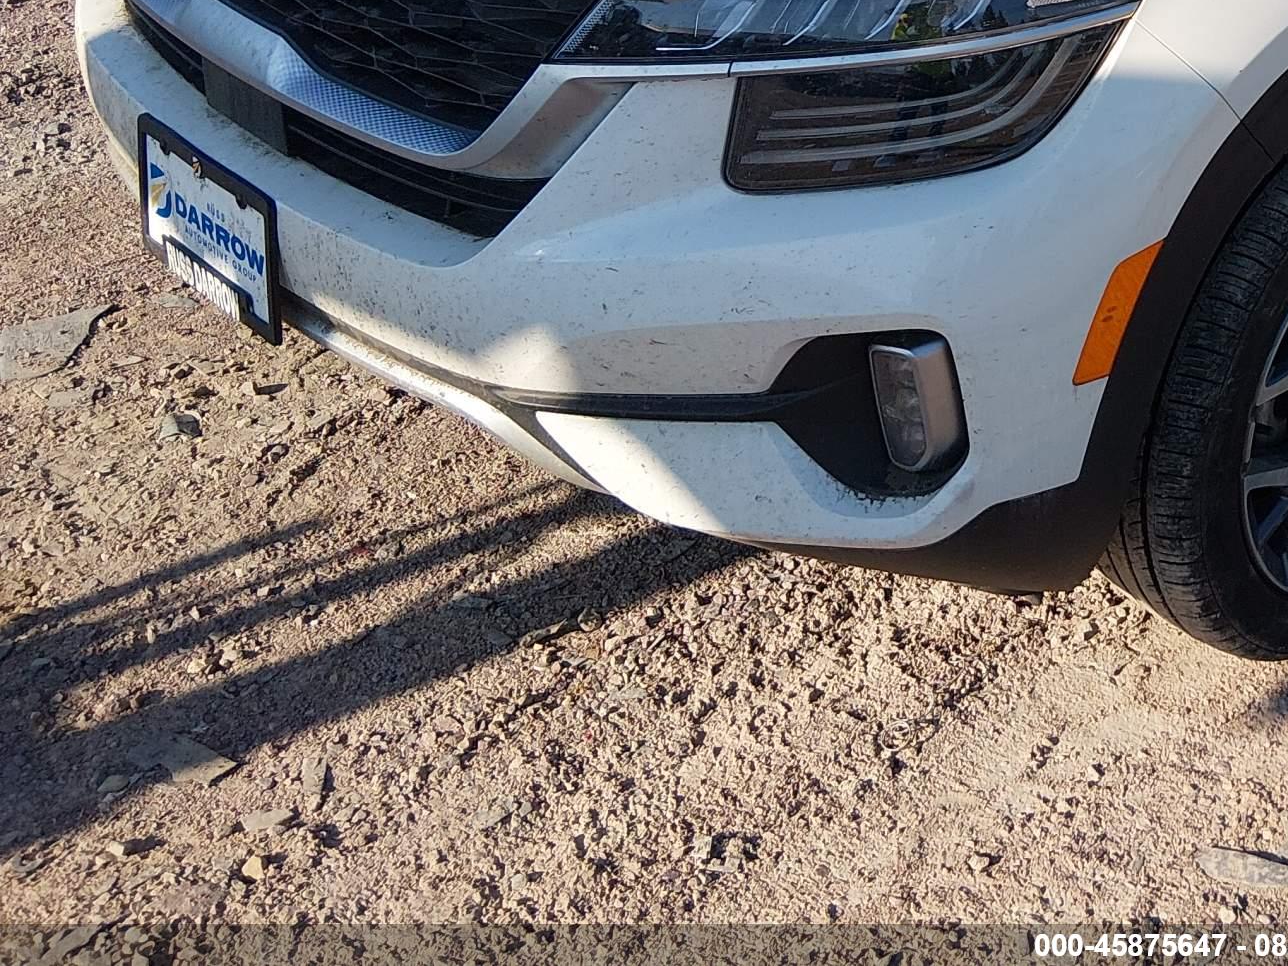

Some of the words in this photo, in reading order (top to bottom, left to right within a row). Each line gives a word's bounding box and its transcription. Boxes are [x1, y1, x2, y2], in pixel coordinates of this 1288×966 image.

[175, 191, 265, 276] DARROW
[206, 203, 225, 222] RUSS
[166, 241, 195, 286] RUSS
[193, 261, 241, 322] DARROW
[184, 226, 229, 263] AUTOMOTIVE
[232, 260, 257, 282] GROUP
